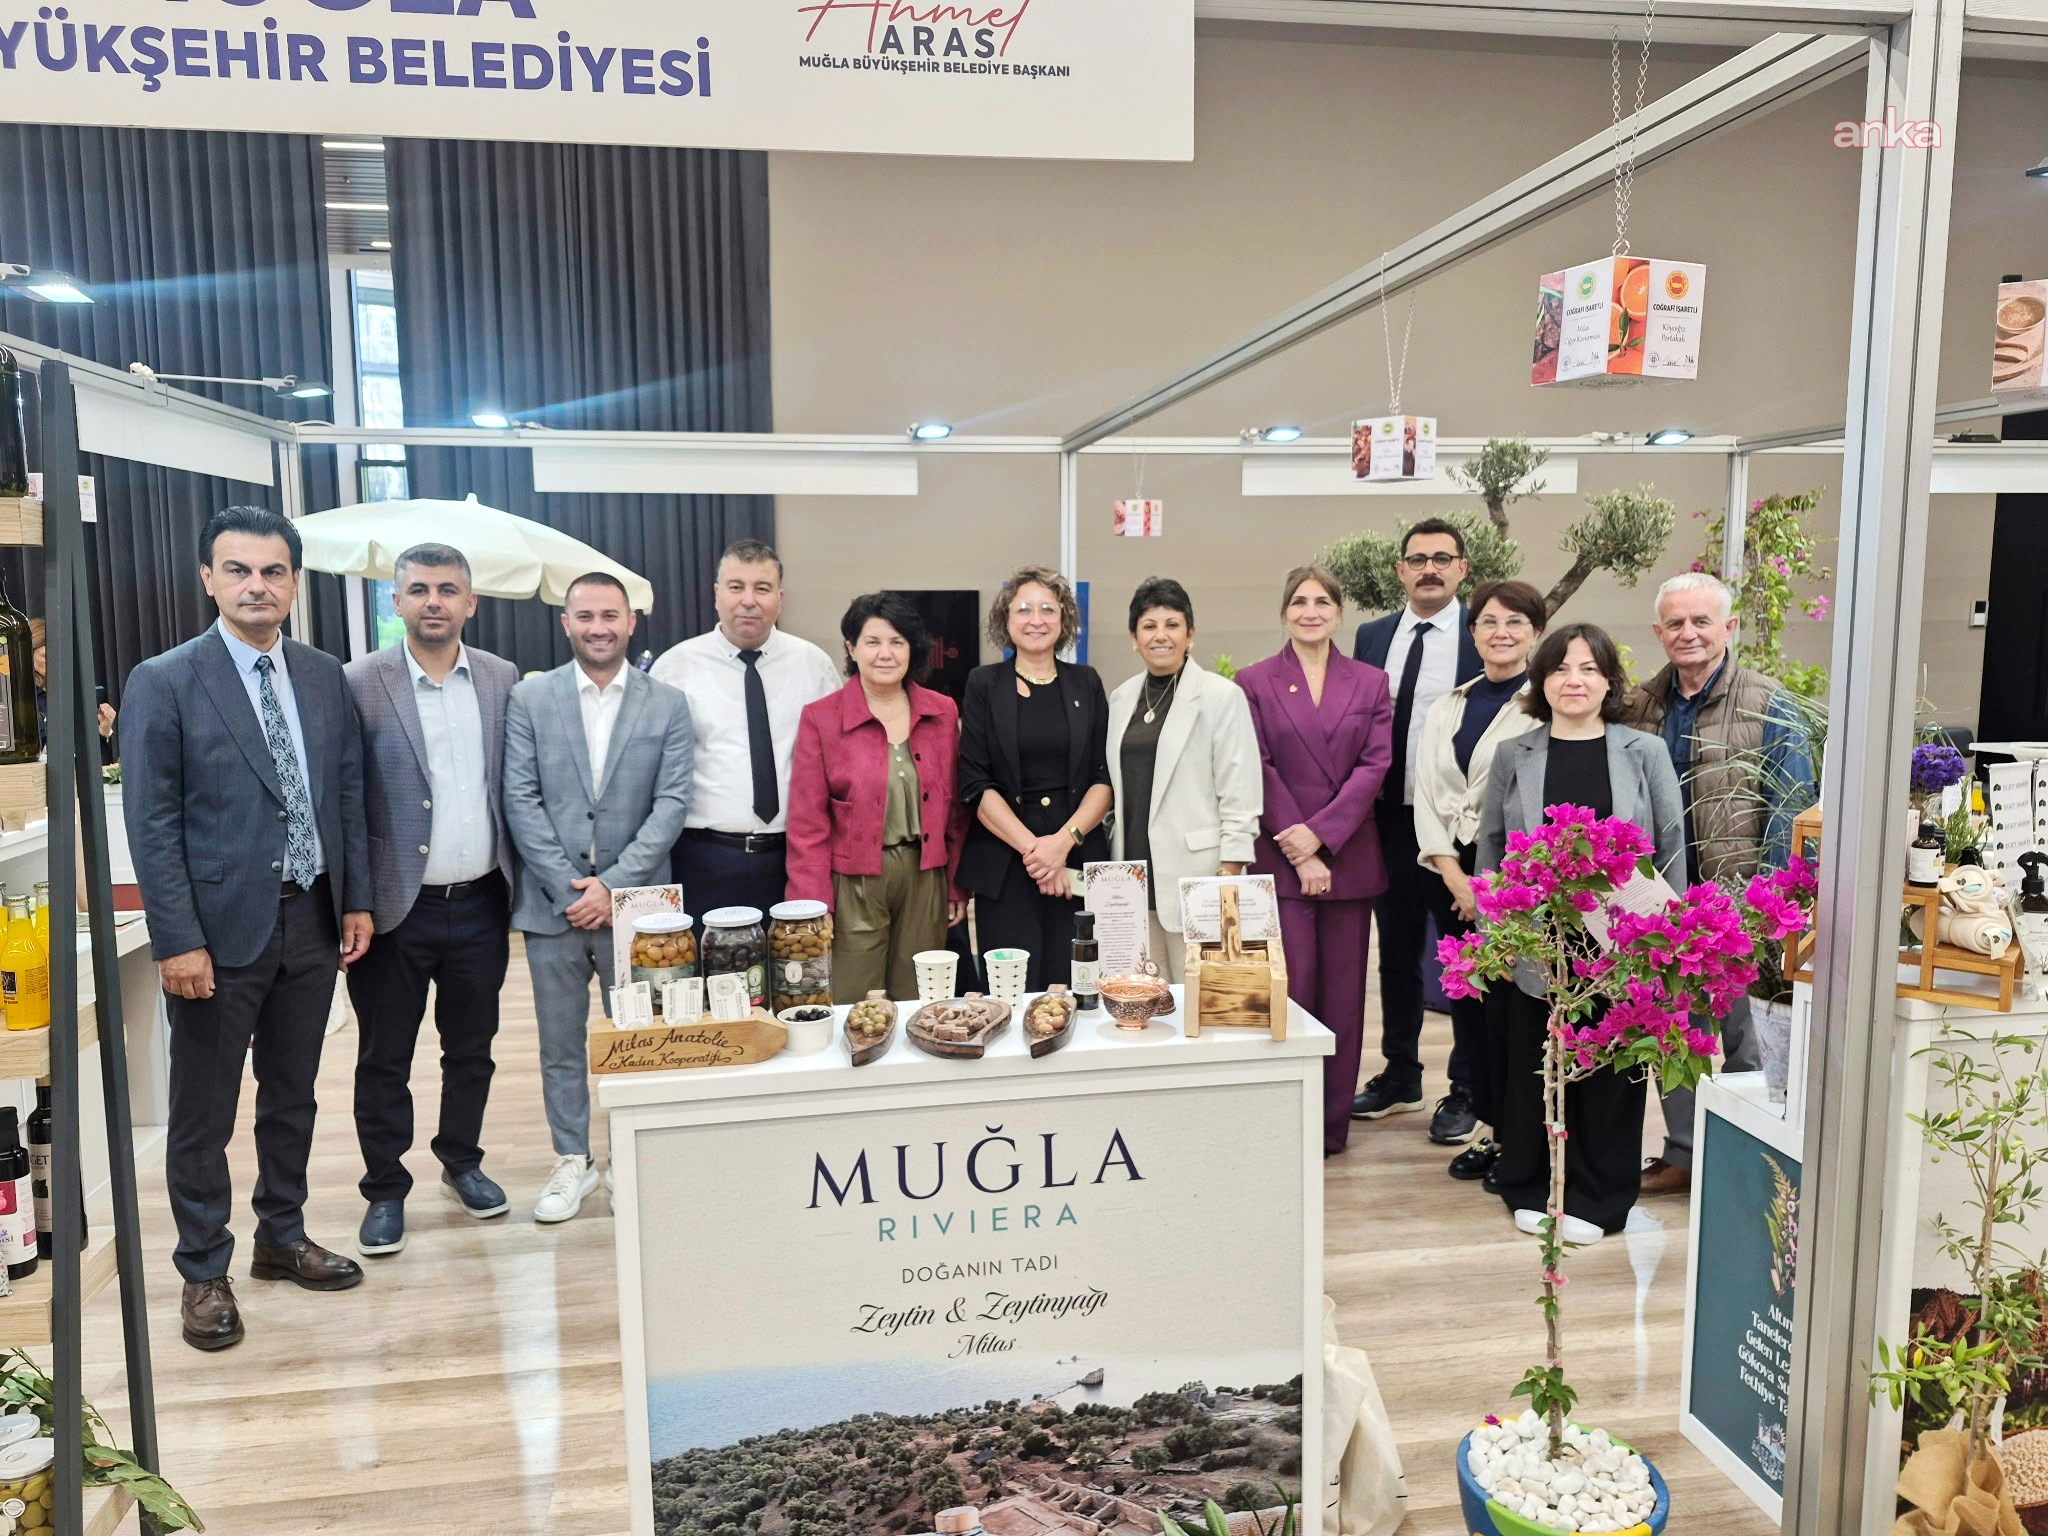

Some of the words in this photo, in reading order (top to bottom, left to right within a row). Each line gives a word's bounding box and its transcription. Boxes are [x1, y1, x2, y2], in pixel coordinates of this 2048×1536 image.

[880, 25, 995, 59] ARAS
[347, 30, 711, 97] BELEDİYESİ
[799, 54, 850, 69] MUĞLA
[853, 56, 940, 75] BÜYÜKŞEHİR
[944, 59, 1010, 75] BELEDİYE
[1013, 65, 1070, 79] BAŞKANI
[1653, 303, 1675, 313] COĞRAFİ
[1676, 304, 1698, 314] İŞARETLİ
[598, 1033, 654, 1067] Milas
[651, 1028, 744, 1055] Anatolie
[609, 1055, 655, 1070] Kadın
[656, 1051, 732, 1066] Kooperatifi
[805, 1123, 1146, 1209] MUĞLA
[878, 1202, 1078, 1242] RIVIERA
[902, 1260, 1002, 1284] DOĞANIN
[1011, 1255, 1058, 1273] TADI
[850, 1304, 935, 1336] Zeytin
[945, 1297, 967, 1323] &
[975, 1285, 1108, 1324] Zeytinyağı
[947, 1332, 1017, 1359] Milas
[1745, 1330, 1773, 1361] Gelen
[1738, 1344, 1775, 1384] Gökova
[1739, 1366, 1776, 1406] Fethiye
